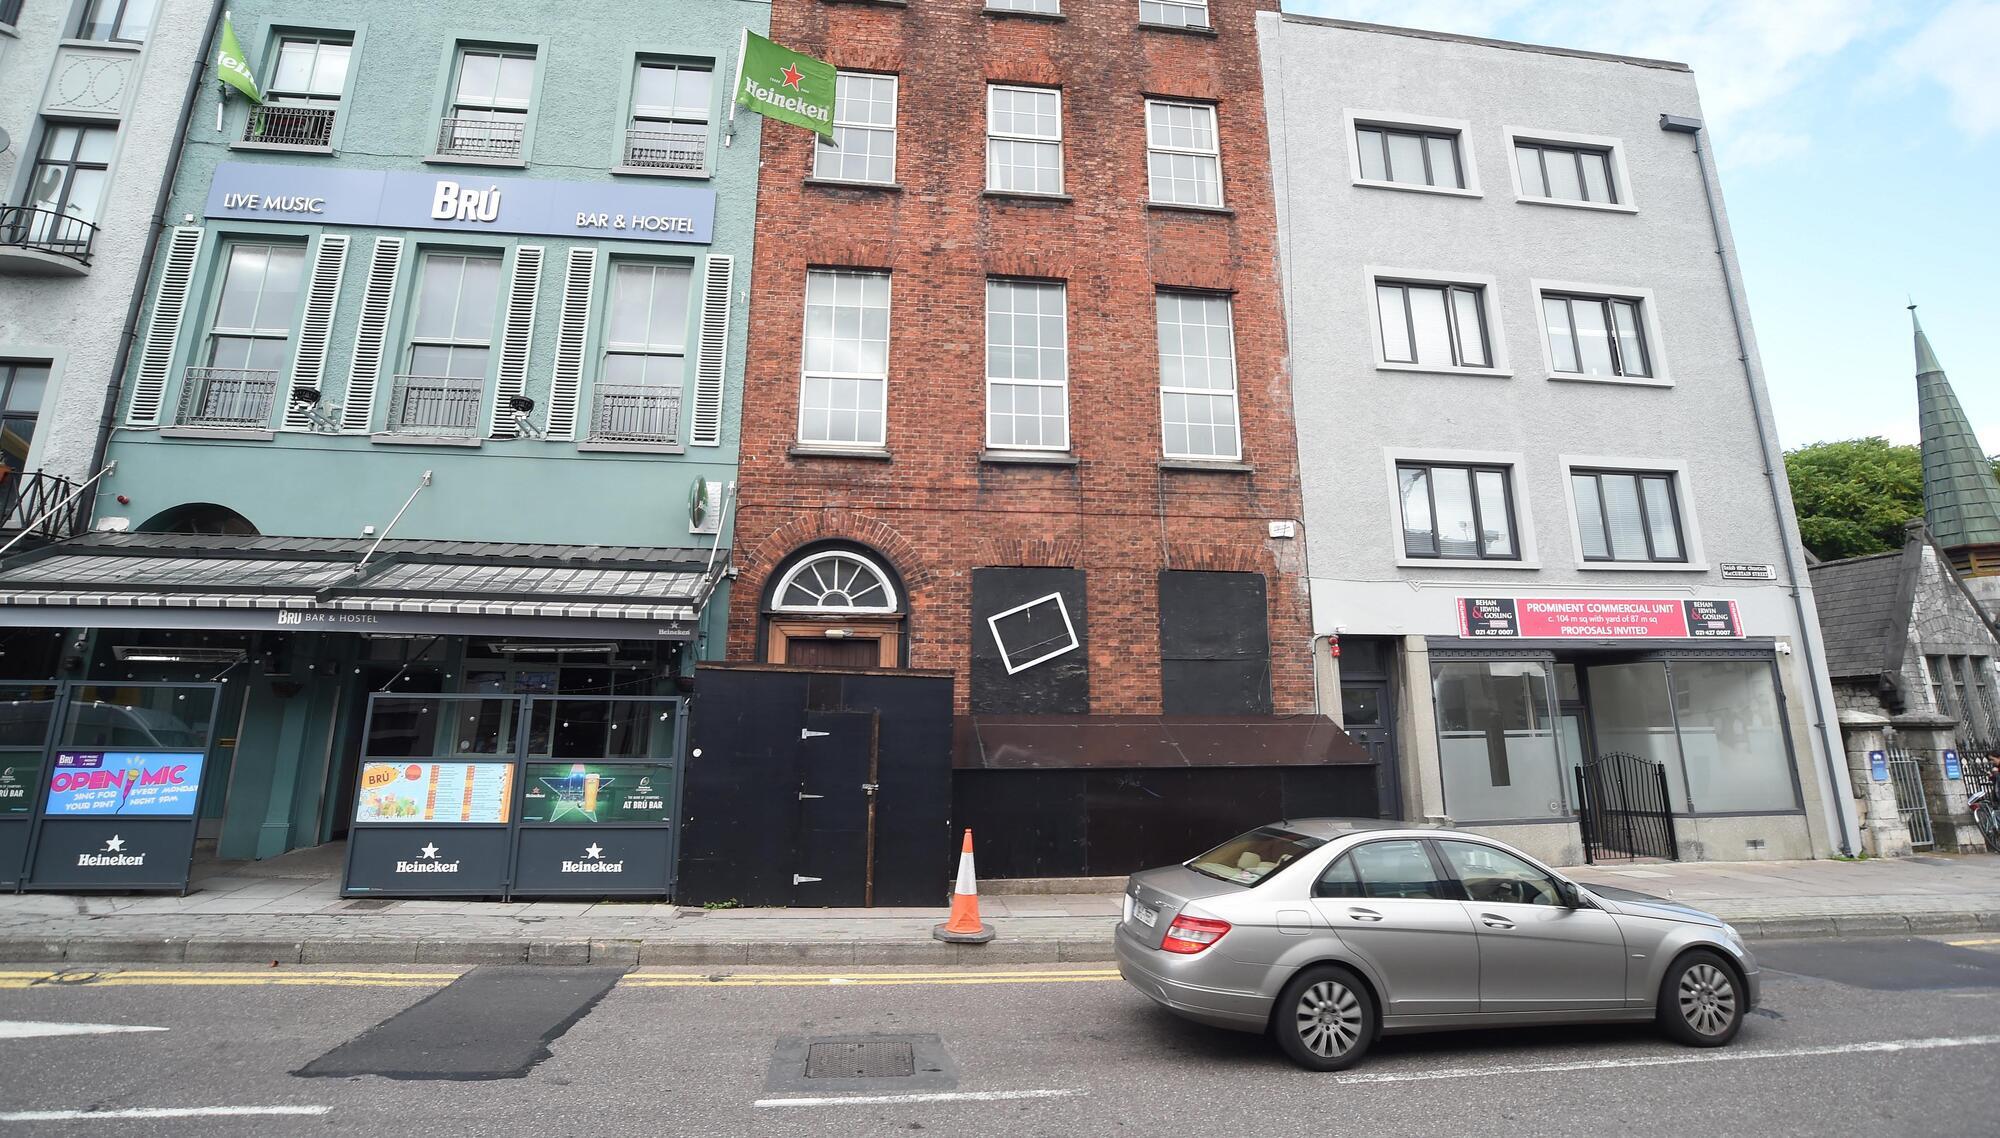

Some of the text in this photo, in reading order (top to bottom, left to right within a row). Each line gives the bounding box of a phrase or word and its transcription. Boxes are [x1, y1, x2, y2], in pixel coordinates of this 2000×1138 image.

[745, 77, 829, 122] Heineken
[224, 193, 324, 213] LIVE MUSIC
[576, 212, 694, 232] BAR & HOSTEL
[1526, 603, 1674, 613] PROMINENT COMMERCIAL UNIT
[305, 614, 325, 622] BAR
[340, 614, 378, 623] HOSTEL
[1605, 615, 1620, 624] yard
[1560, 626, 1648, 635] PROPOSALS INVITED
[51, 765, 187, 792] OPEN MIC
[368, 771, 390, 784] BRÚ
[0, 788, 24, 797] RÚ BAR
[97, 790, 117, 799] FOR
[130, 788, 159, 796] EVERY
[65, 800, 115, 810] YOUR PINT
[130, 797, 156, 805] NIGHT
[623, 799, 663, 809] AT BRÚ BAR
[78, 853, 145, 866] Heineken
[396, 860, 460, 873] Heineken
[562, 860, 623, 873] Heineken
